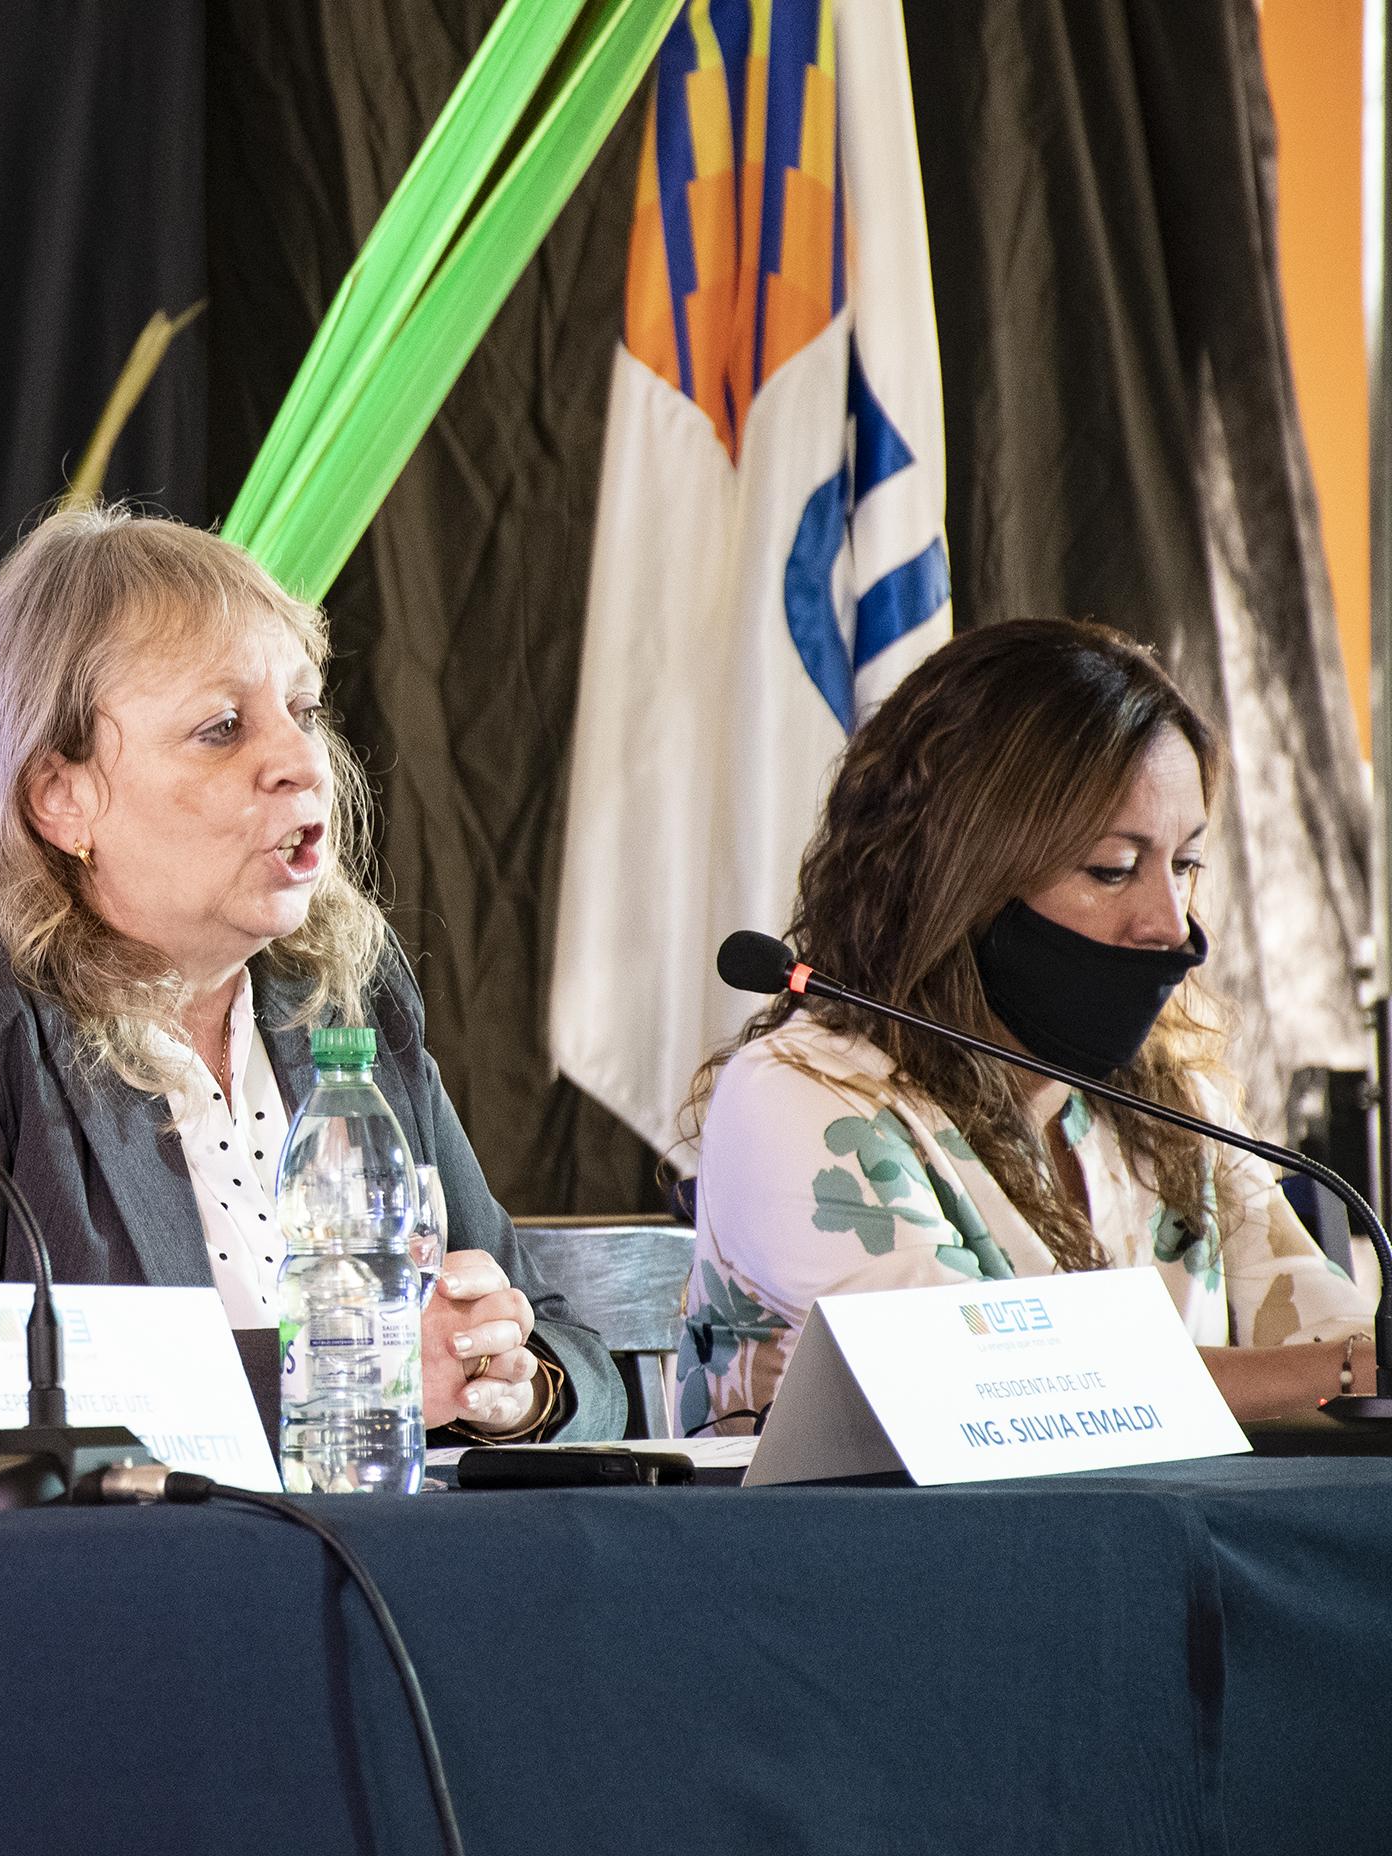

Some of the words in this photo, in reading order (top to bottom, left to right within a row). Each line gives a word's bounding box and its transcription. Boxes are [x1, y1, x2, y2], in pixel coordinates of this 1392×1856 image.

[982, 1298, 1053, 1333] UTE
[975, 1377, 1057, 1400] PRESIDENTA
[1056, 1374, 1077, 1392] DE
[1078, 1371, 1107, 1389] UTE
[101, 1393, 123, 1412] DE
[124, 1393, 155, 1412] UTE
[959, 1420, 1012, 1448] ING.
[1010, 1413, 1080, 1443] SILVIA
[1076, 1404, 1164, 1436] EMALDI
